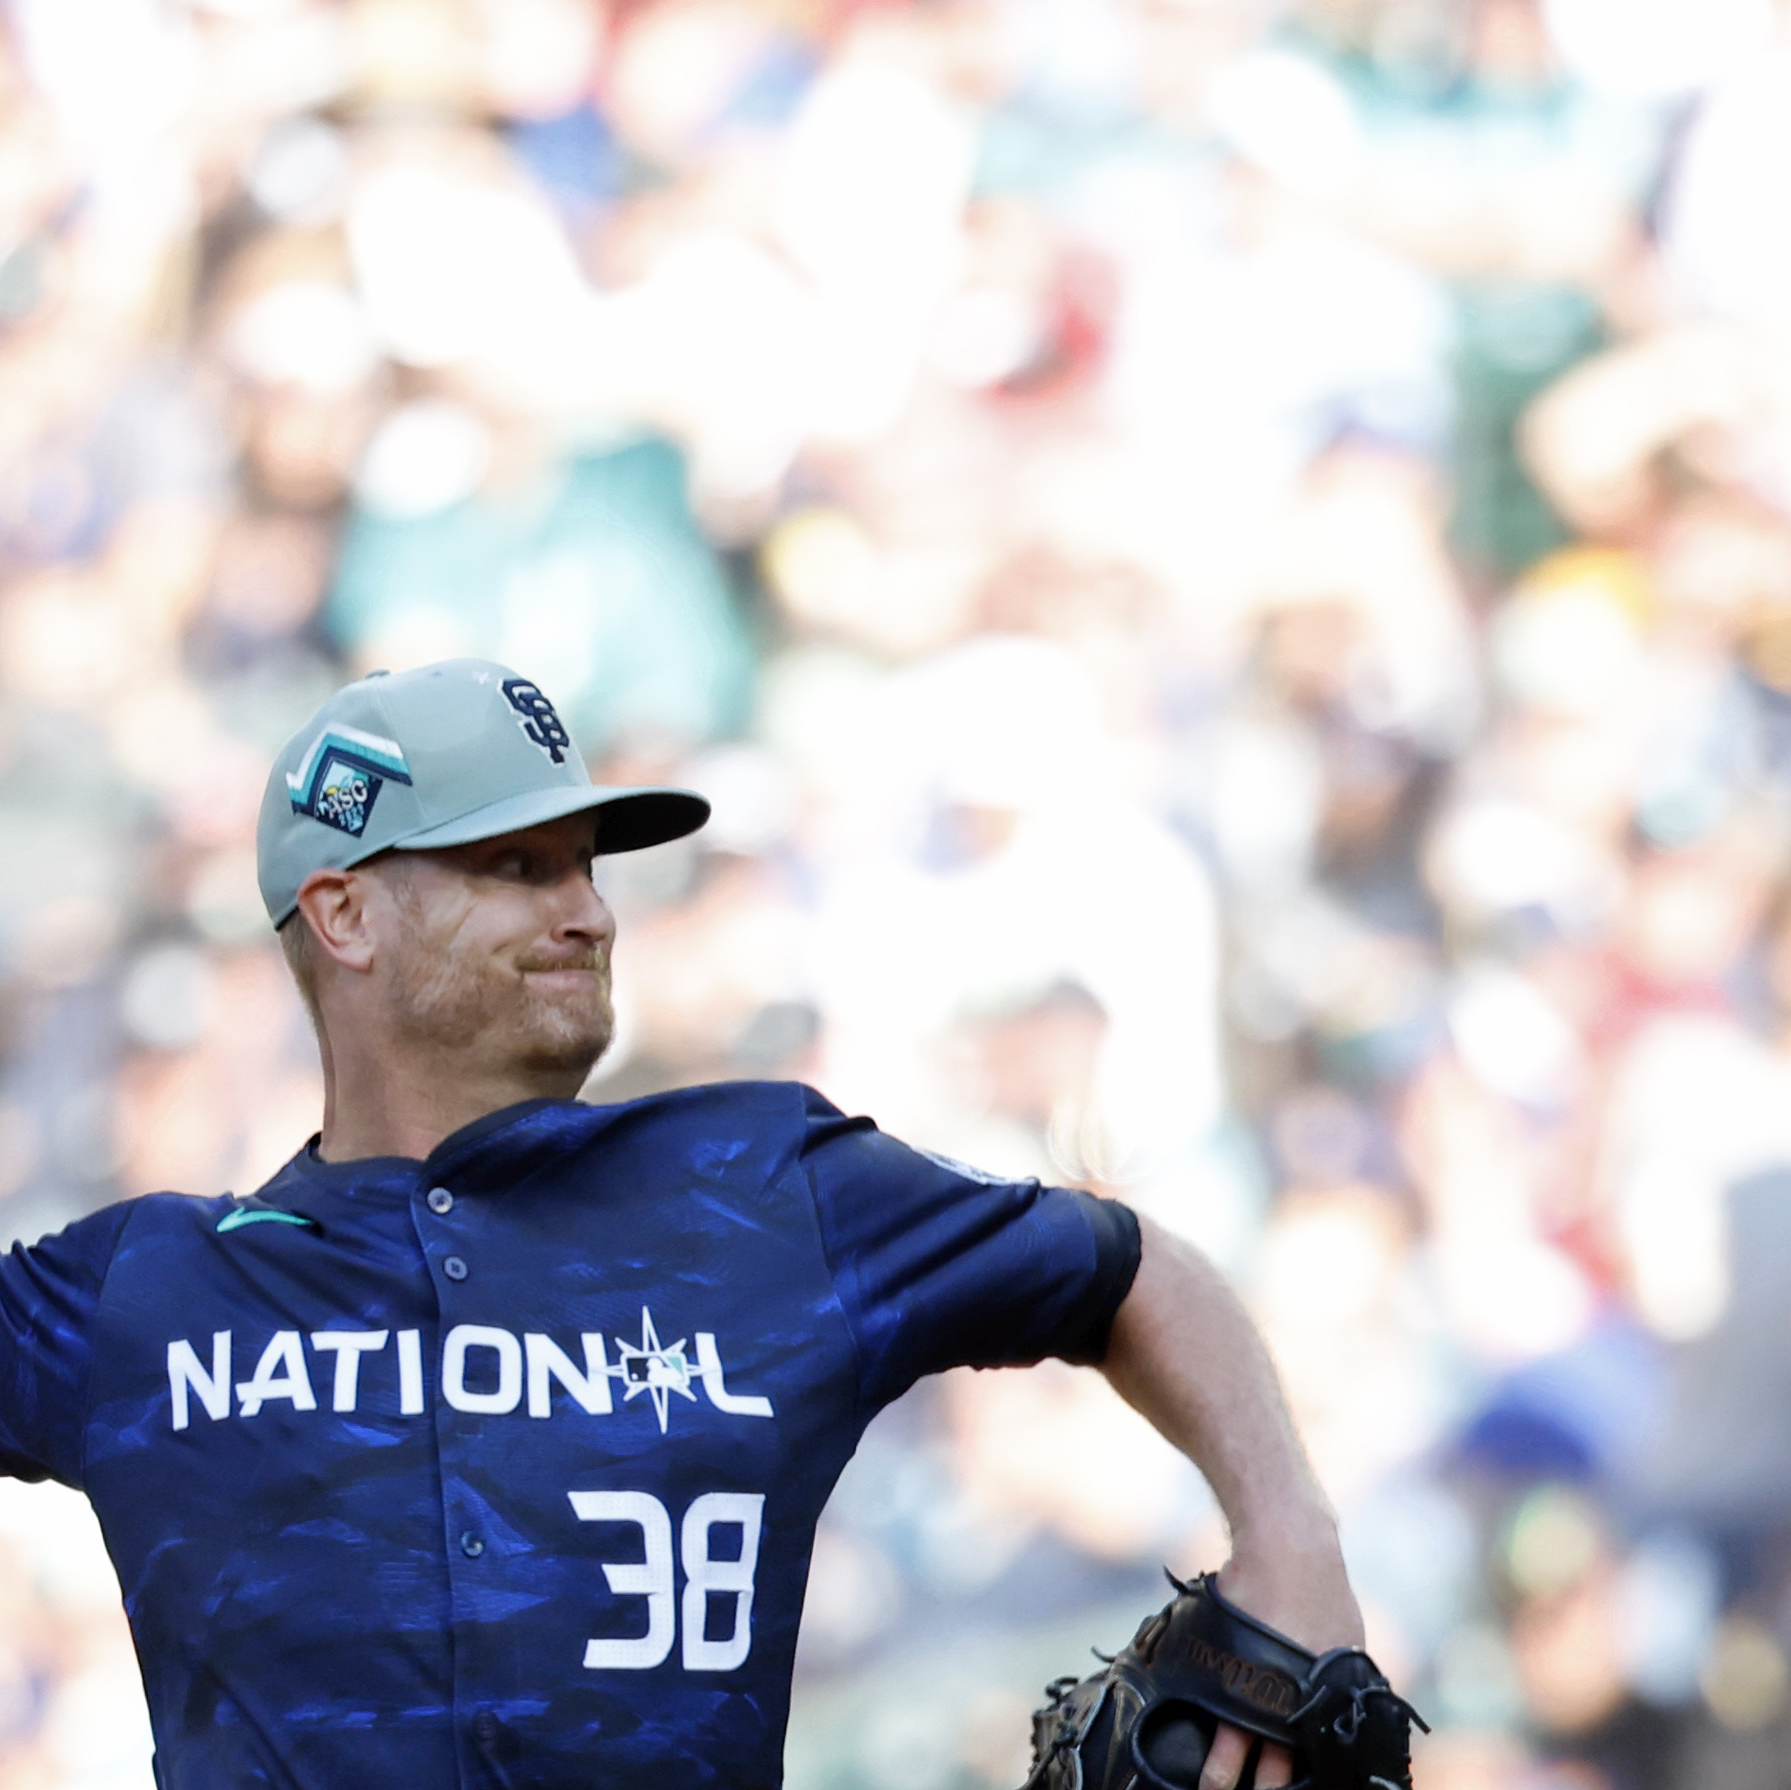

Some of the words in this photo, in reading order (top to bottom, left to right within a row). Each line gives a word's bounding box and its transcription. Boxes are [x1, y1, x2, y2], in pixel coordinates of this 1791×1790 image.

[326, 779, 368, 820] ASC
[167, 1315, 774, 1434] NATIONL
[567, 1491, 765, 1671] 38
